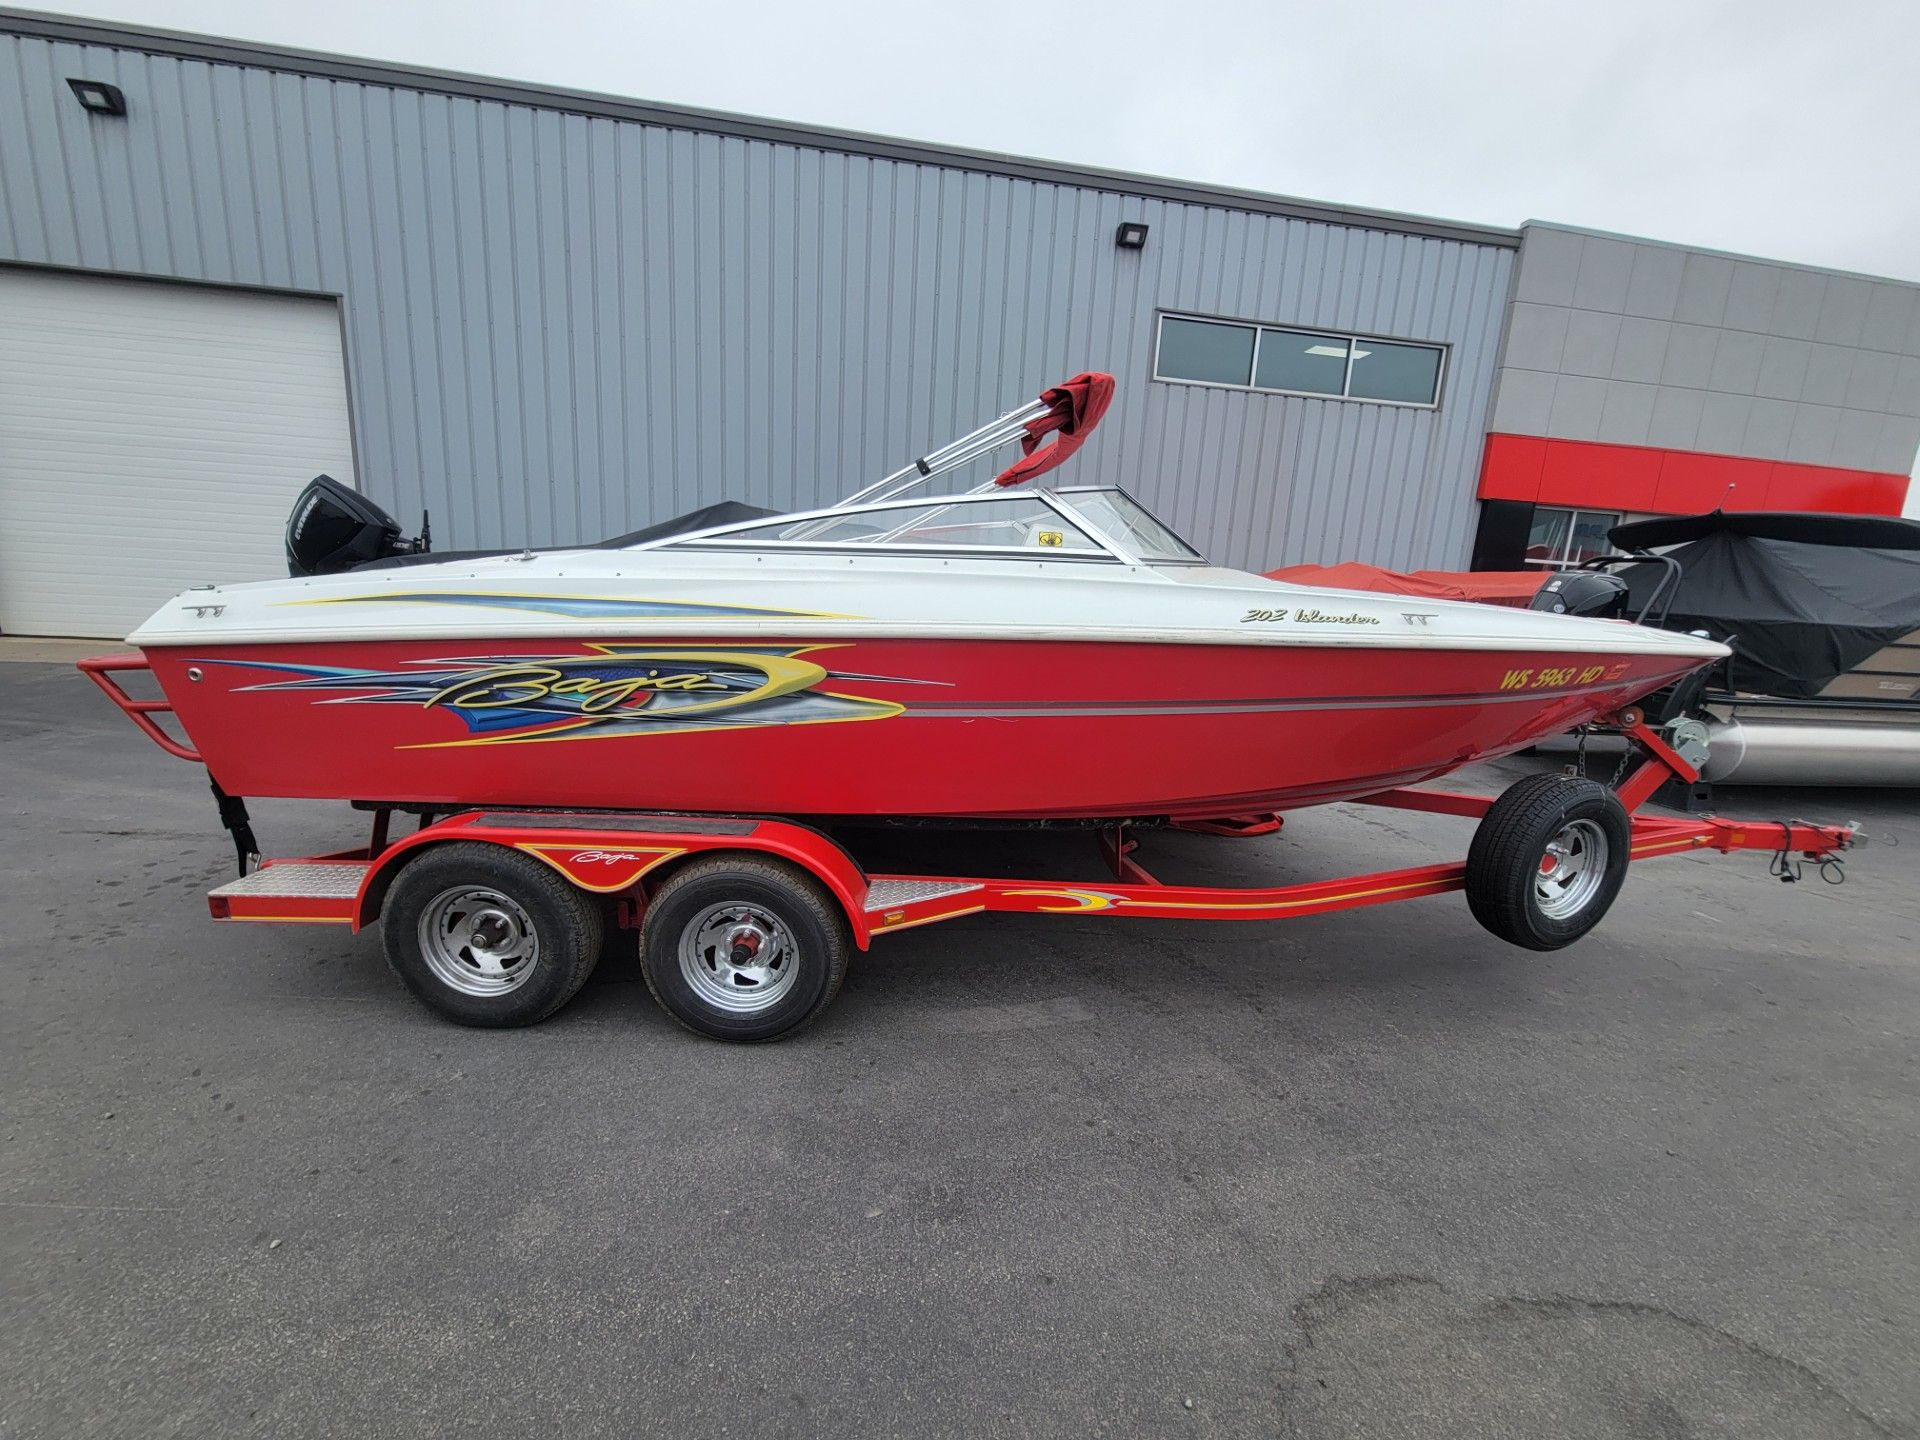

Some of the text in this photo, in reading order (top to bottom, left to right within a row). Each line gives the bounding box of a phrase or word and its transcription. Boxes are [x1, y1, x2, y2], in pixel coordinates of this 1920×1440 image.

[1239, 608, 1380, 624] 202 Islander
[1500, 669, 1534, 689] WS
[1530, 667, 1577, 688] 5963
[1574, 665, 1605, 684] HD
[423, 668, 728, 712] Baja
[569, 850, 640, 865] Baja
